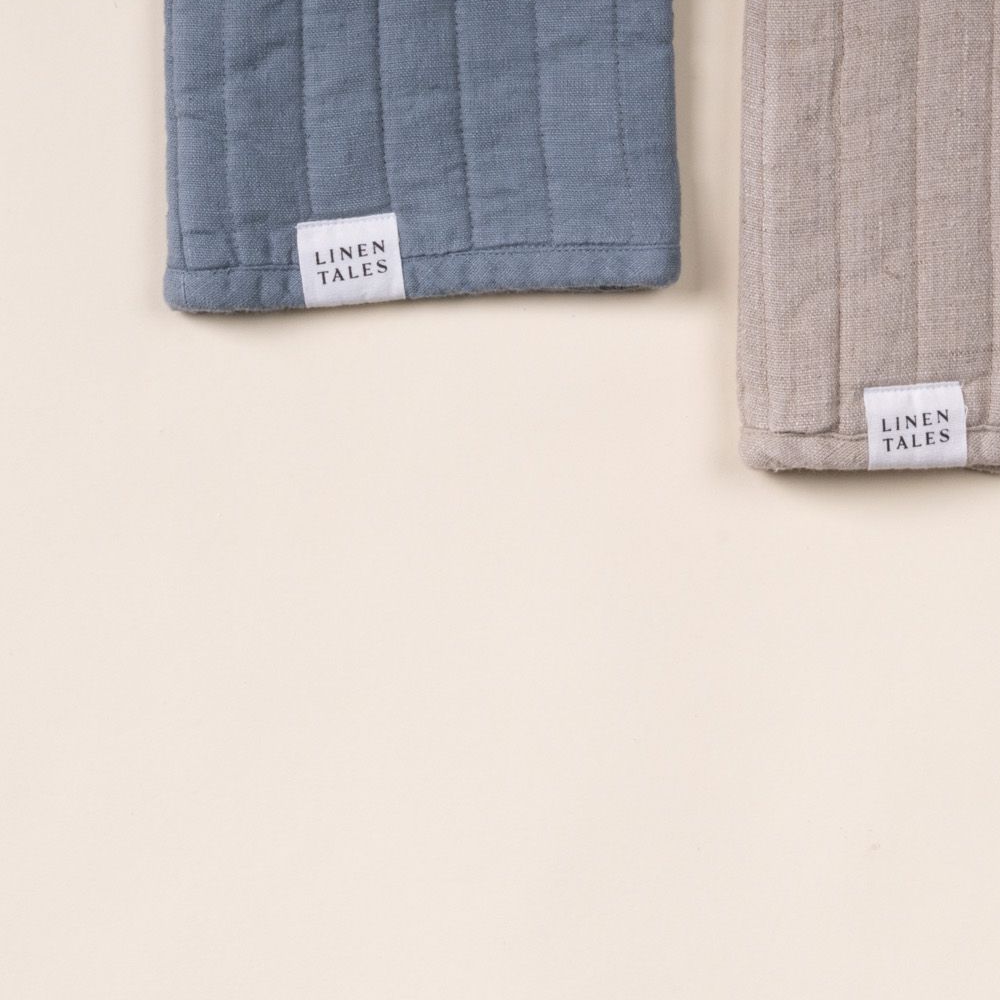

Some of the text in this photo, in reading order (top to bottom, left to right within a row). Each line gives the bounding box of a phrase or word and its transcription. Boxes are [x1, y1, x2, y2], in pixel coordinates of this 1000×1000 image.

[315, 239, 385, 266] LINEN
[317, 259, 388, 285] TALES
[881, 409, 949, 433] LINEN
[882, 428, 950, 453] TALES
